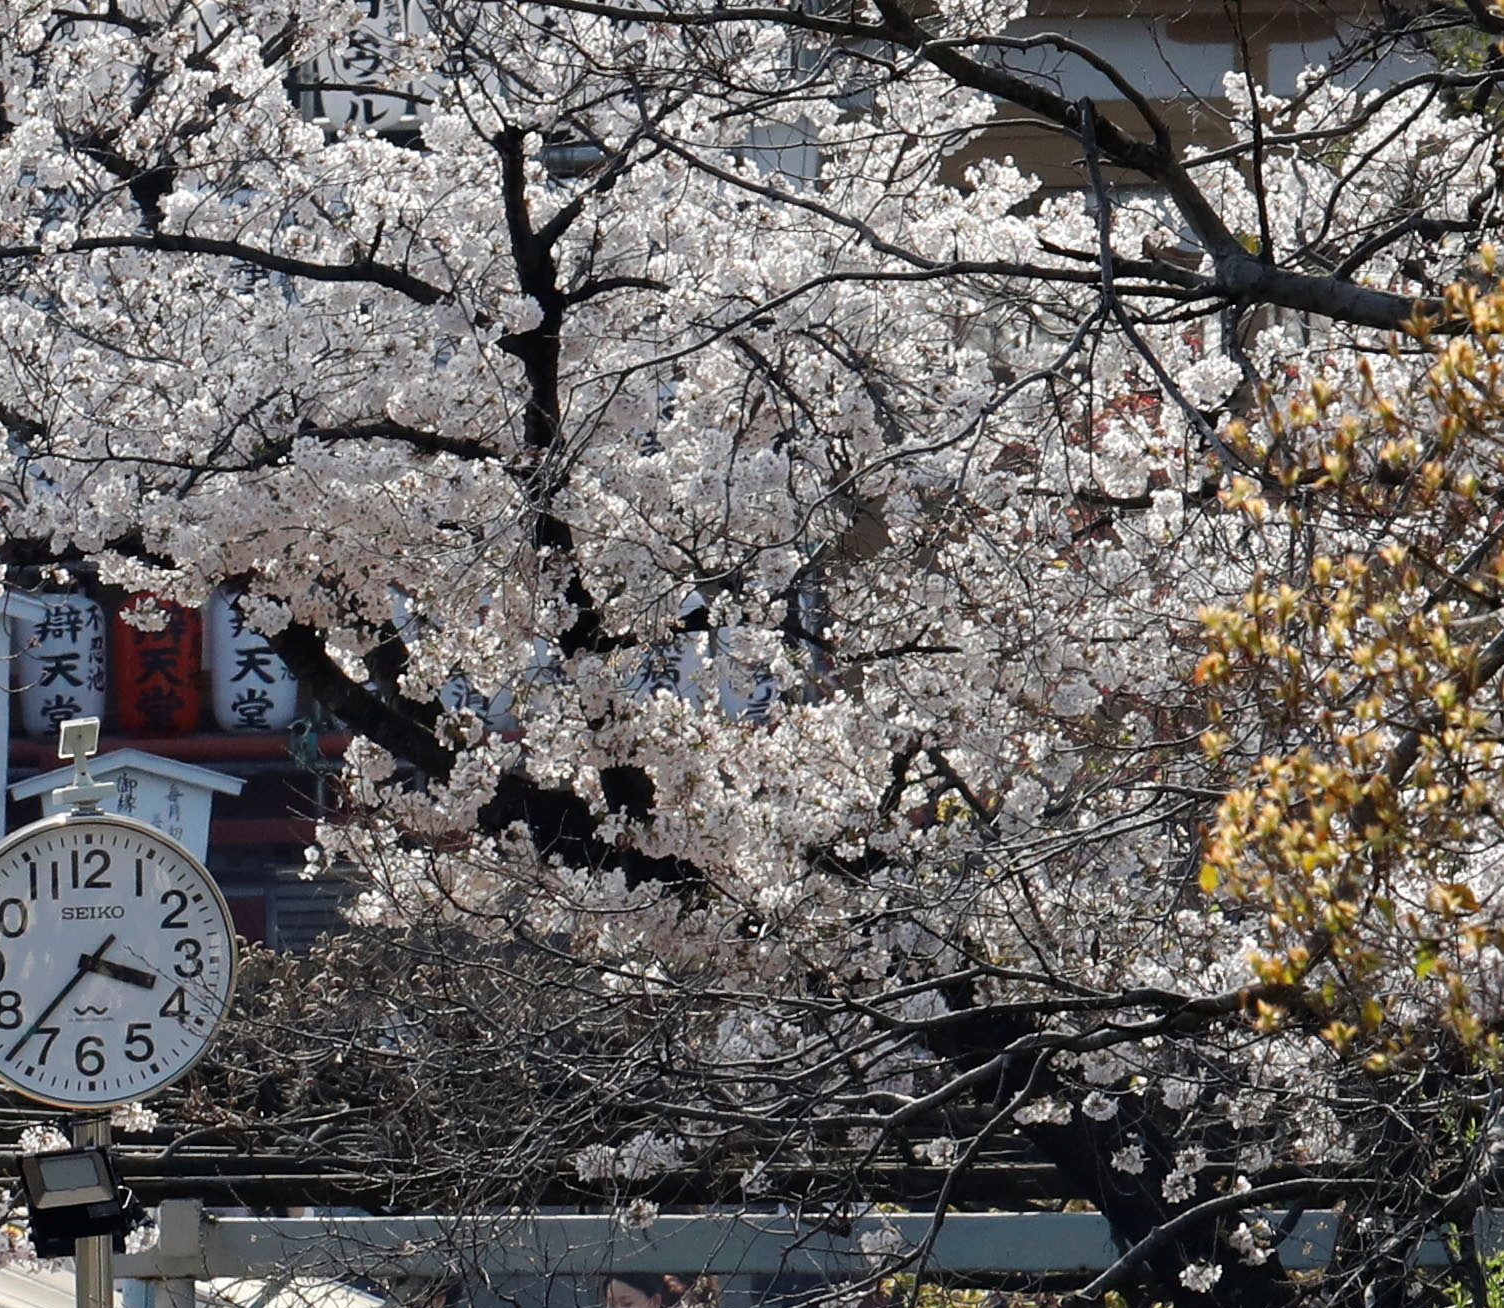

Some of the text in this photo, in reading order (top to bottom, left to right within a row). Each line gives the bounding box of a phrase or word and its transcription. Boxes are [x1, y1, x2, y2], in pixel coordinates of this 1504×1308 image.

[86, 604, 106, 693] 不忍池
[29, 861, 59, 900] 11
[71, 849, 112, 889] 12
[136, 858, 143, 897] 1
[61, 906, 125, 920] SEIKO
[160, 889, 189, 929] 2
[173, 938, 204, 978] 3
[158, 985, 190, 1022] 4
[35, 1027, 61, 1065] 7
[75, 1036, 105, 1077] 6
[125, 1022, 155, 1062] 5
